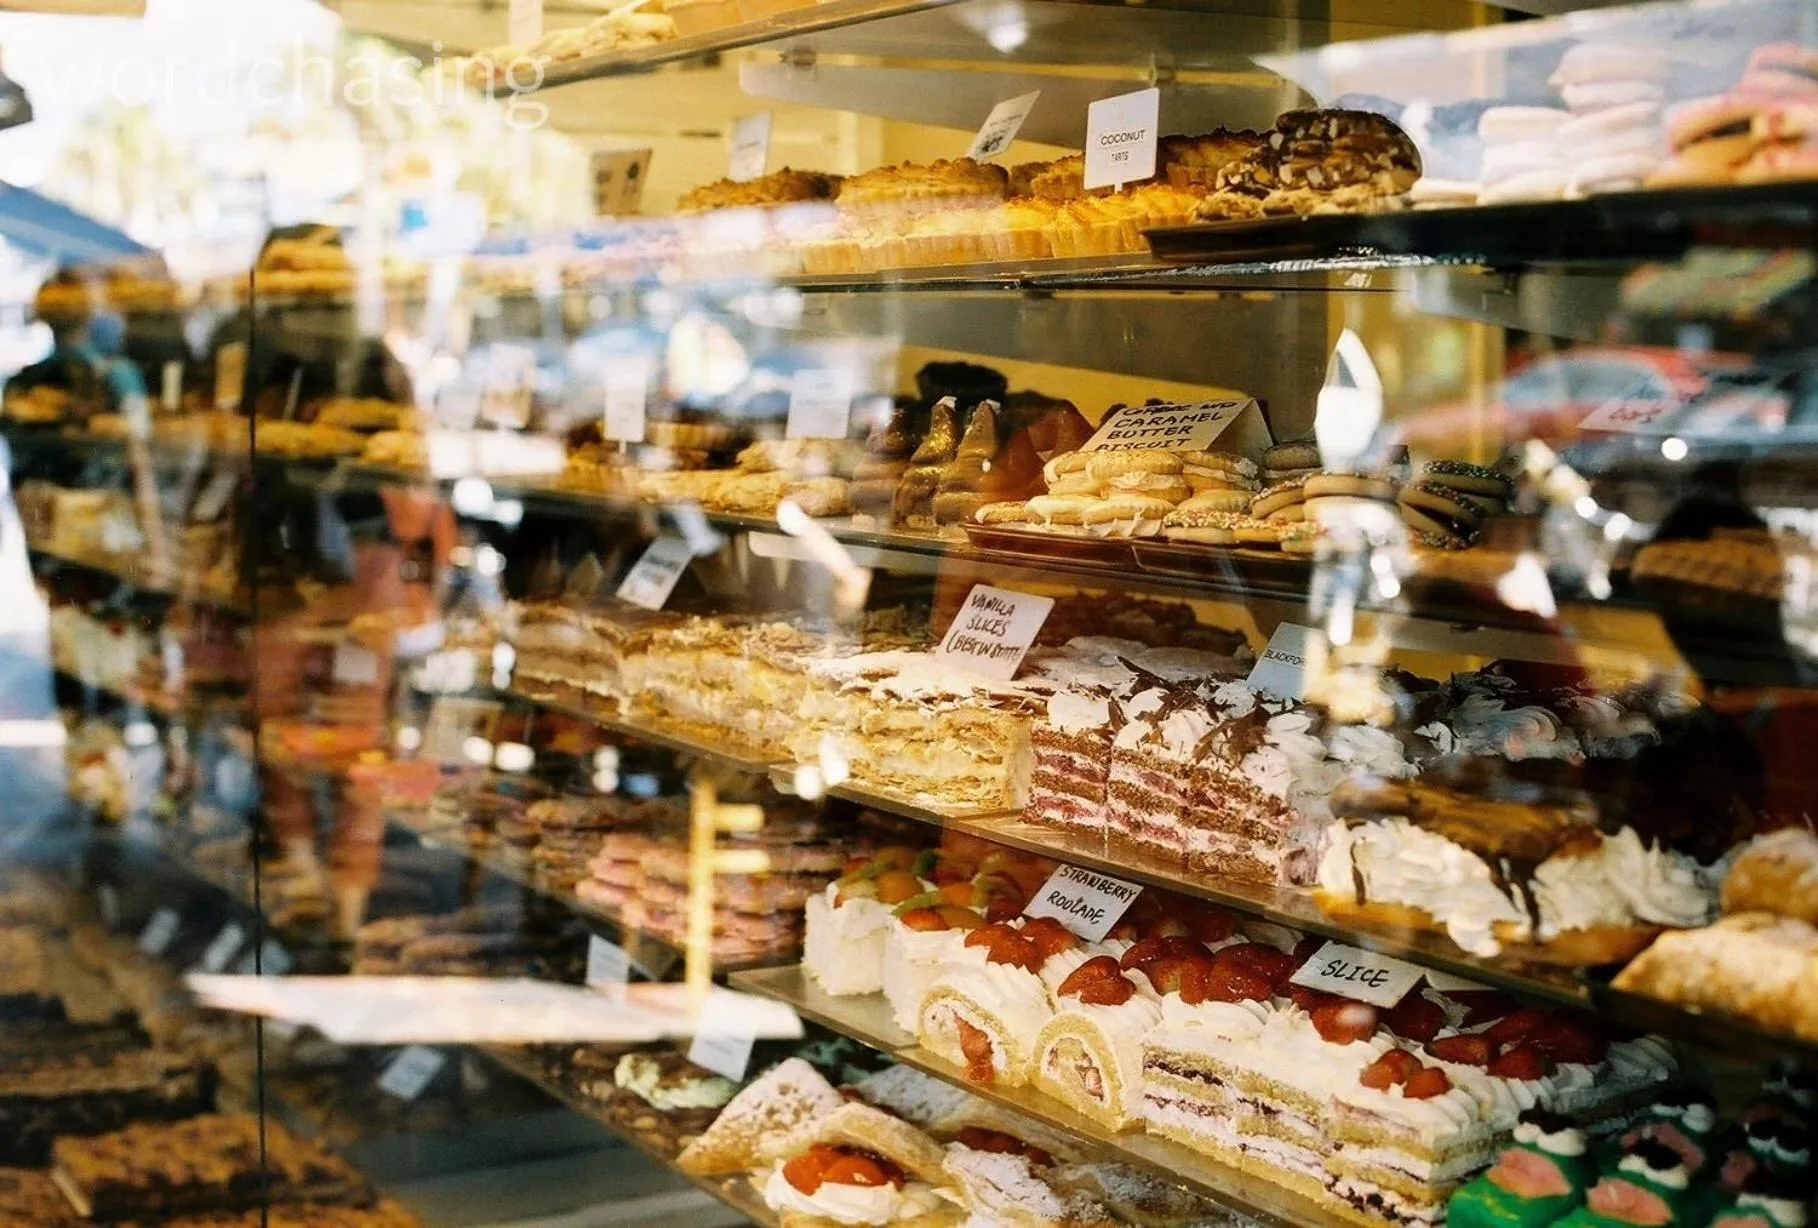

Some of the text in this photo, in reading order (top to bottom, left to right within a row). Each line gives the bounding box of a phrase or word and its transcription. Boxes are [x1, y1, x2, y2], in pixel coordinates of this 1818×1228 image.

[1100, 129, 1145, 146] COCONUT
[1114, 410, 1224, 429] CARAMEL
[1106, 425, 1194, 440] BUTTER
[1094, 438, 1192, 451] BISCUIT
[971, 593, 1015, 617] VANILLA
[966, 614, 1011, 637] SLICES
[1060, 865, 1137, 904] STRAWBERRY
[1046, 890, 1105, 925] ROULADE
[1321, 959, 1390, 988] SLICE
